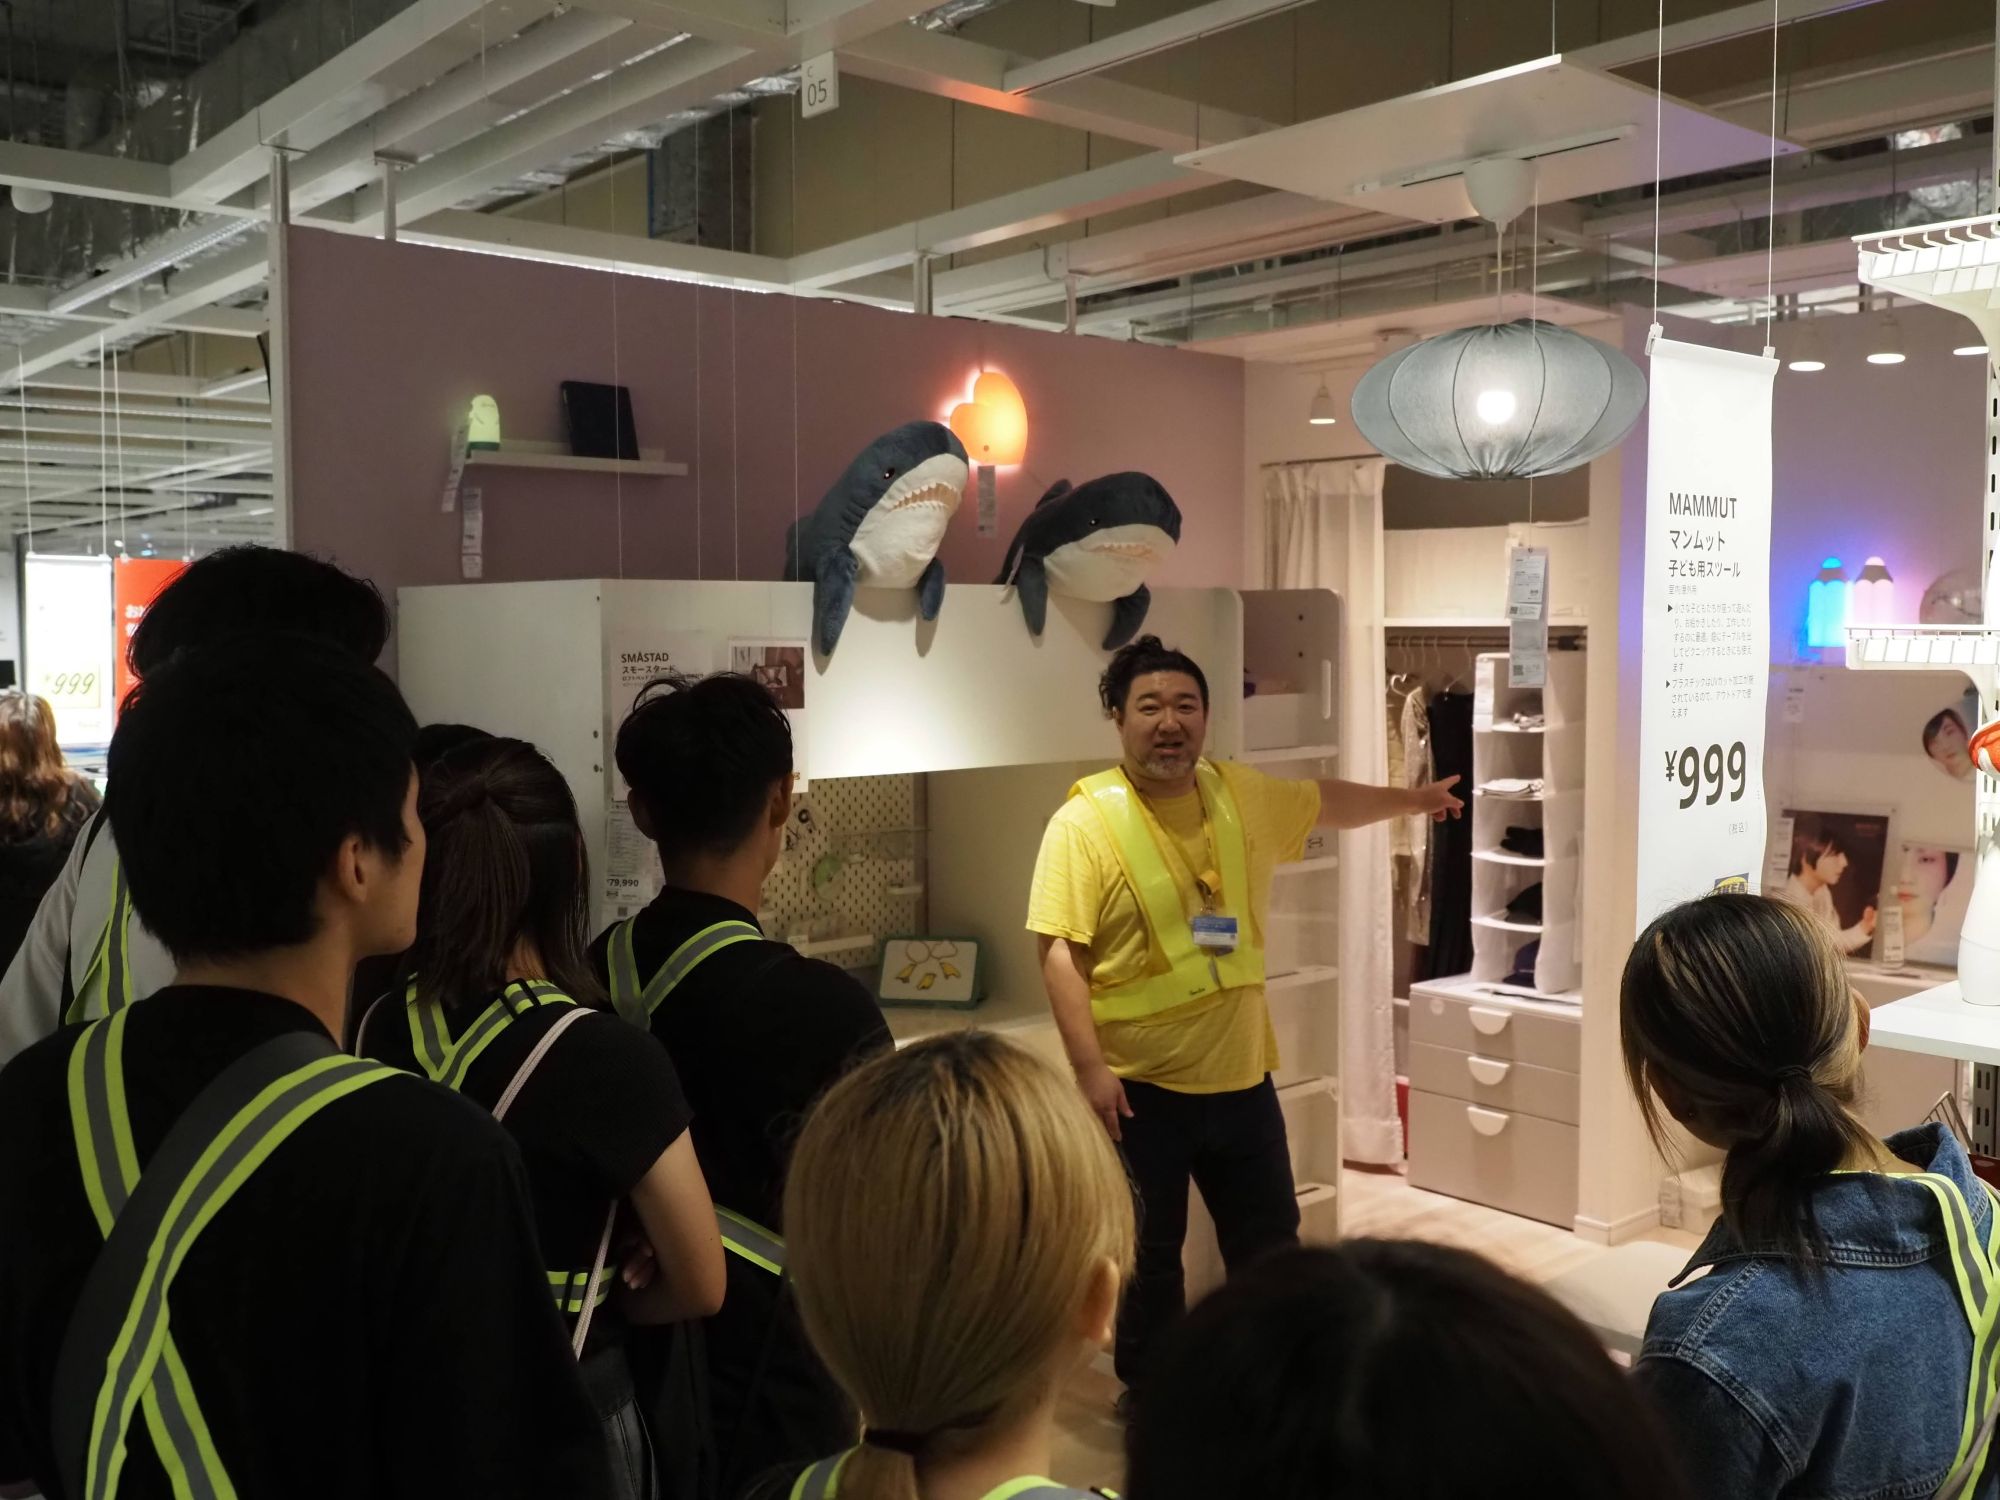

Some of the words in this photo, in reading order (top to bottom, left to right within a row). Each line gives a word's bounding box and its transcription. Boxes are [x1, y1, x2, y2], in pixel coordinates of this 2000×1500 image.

[808, 79, 827, 106] 05
[1669, 492, 1737, 519] MAMMUT
[1669, 530, 1725, 551] マンムット
[1668, 559, 1741, 578] 子ども用スツール
[621, 652, 669, 663] SMÅSTAD
[1665, 741, 1746, 809] ¥999
